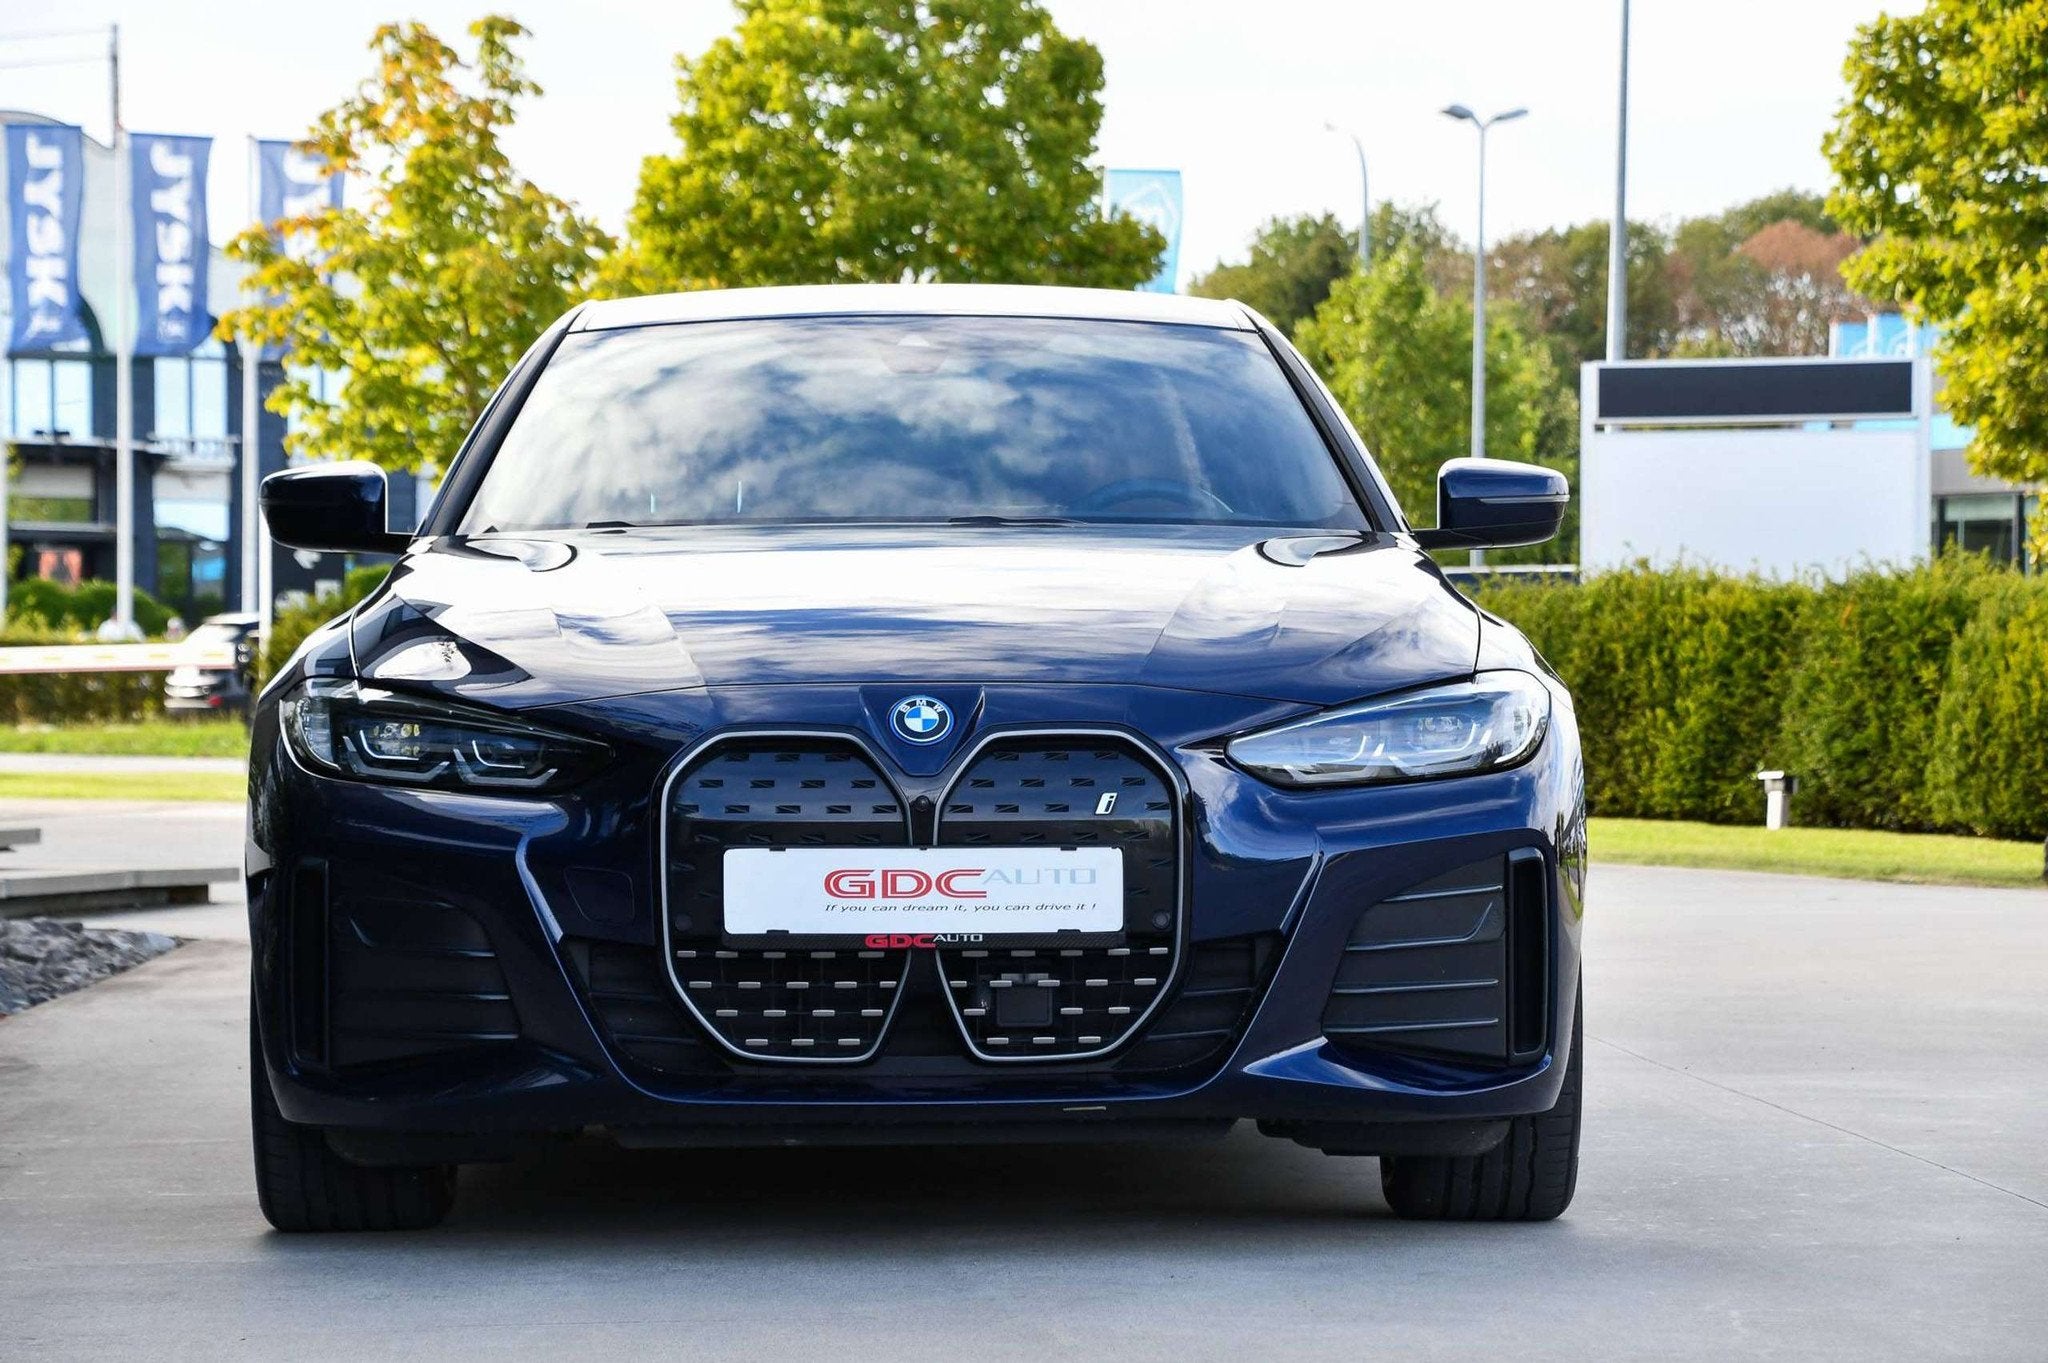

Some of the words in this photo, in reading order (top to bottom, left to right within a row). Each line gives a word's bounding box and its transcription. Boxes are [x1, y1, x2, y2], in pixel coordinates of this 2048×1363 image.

[24, 131, 68, 308] JYSK
[150, 140, 194, 315] JYSK
[899, 700, 945, 713] BMW
[825, 904, 838, 912] If
[840, 904, 867, 913] you
[872, 904, 898, 912] can
[902, 903, 949, 912] dream
[953, 903, 968, 913] it,
[974, 903, 1000, 912] you
[1004, 903, 1031, 911] can
[1035, 902, 1072, 912] drive
[1076, 902, 1086, 911] it
